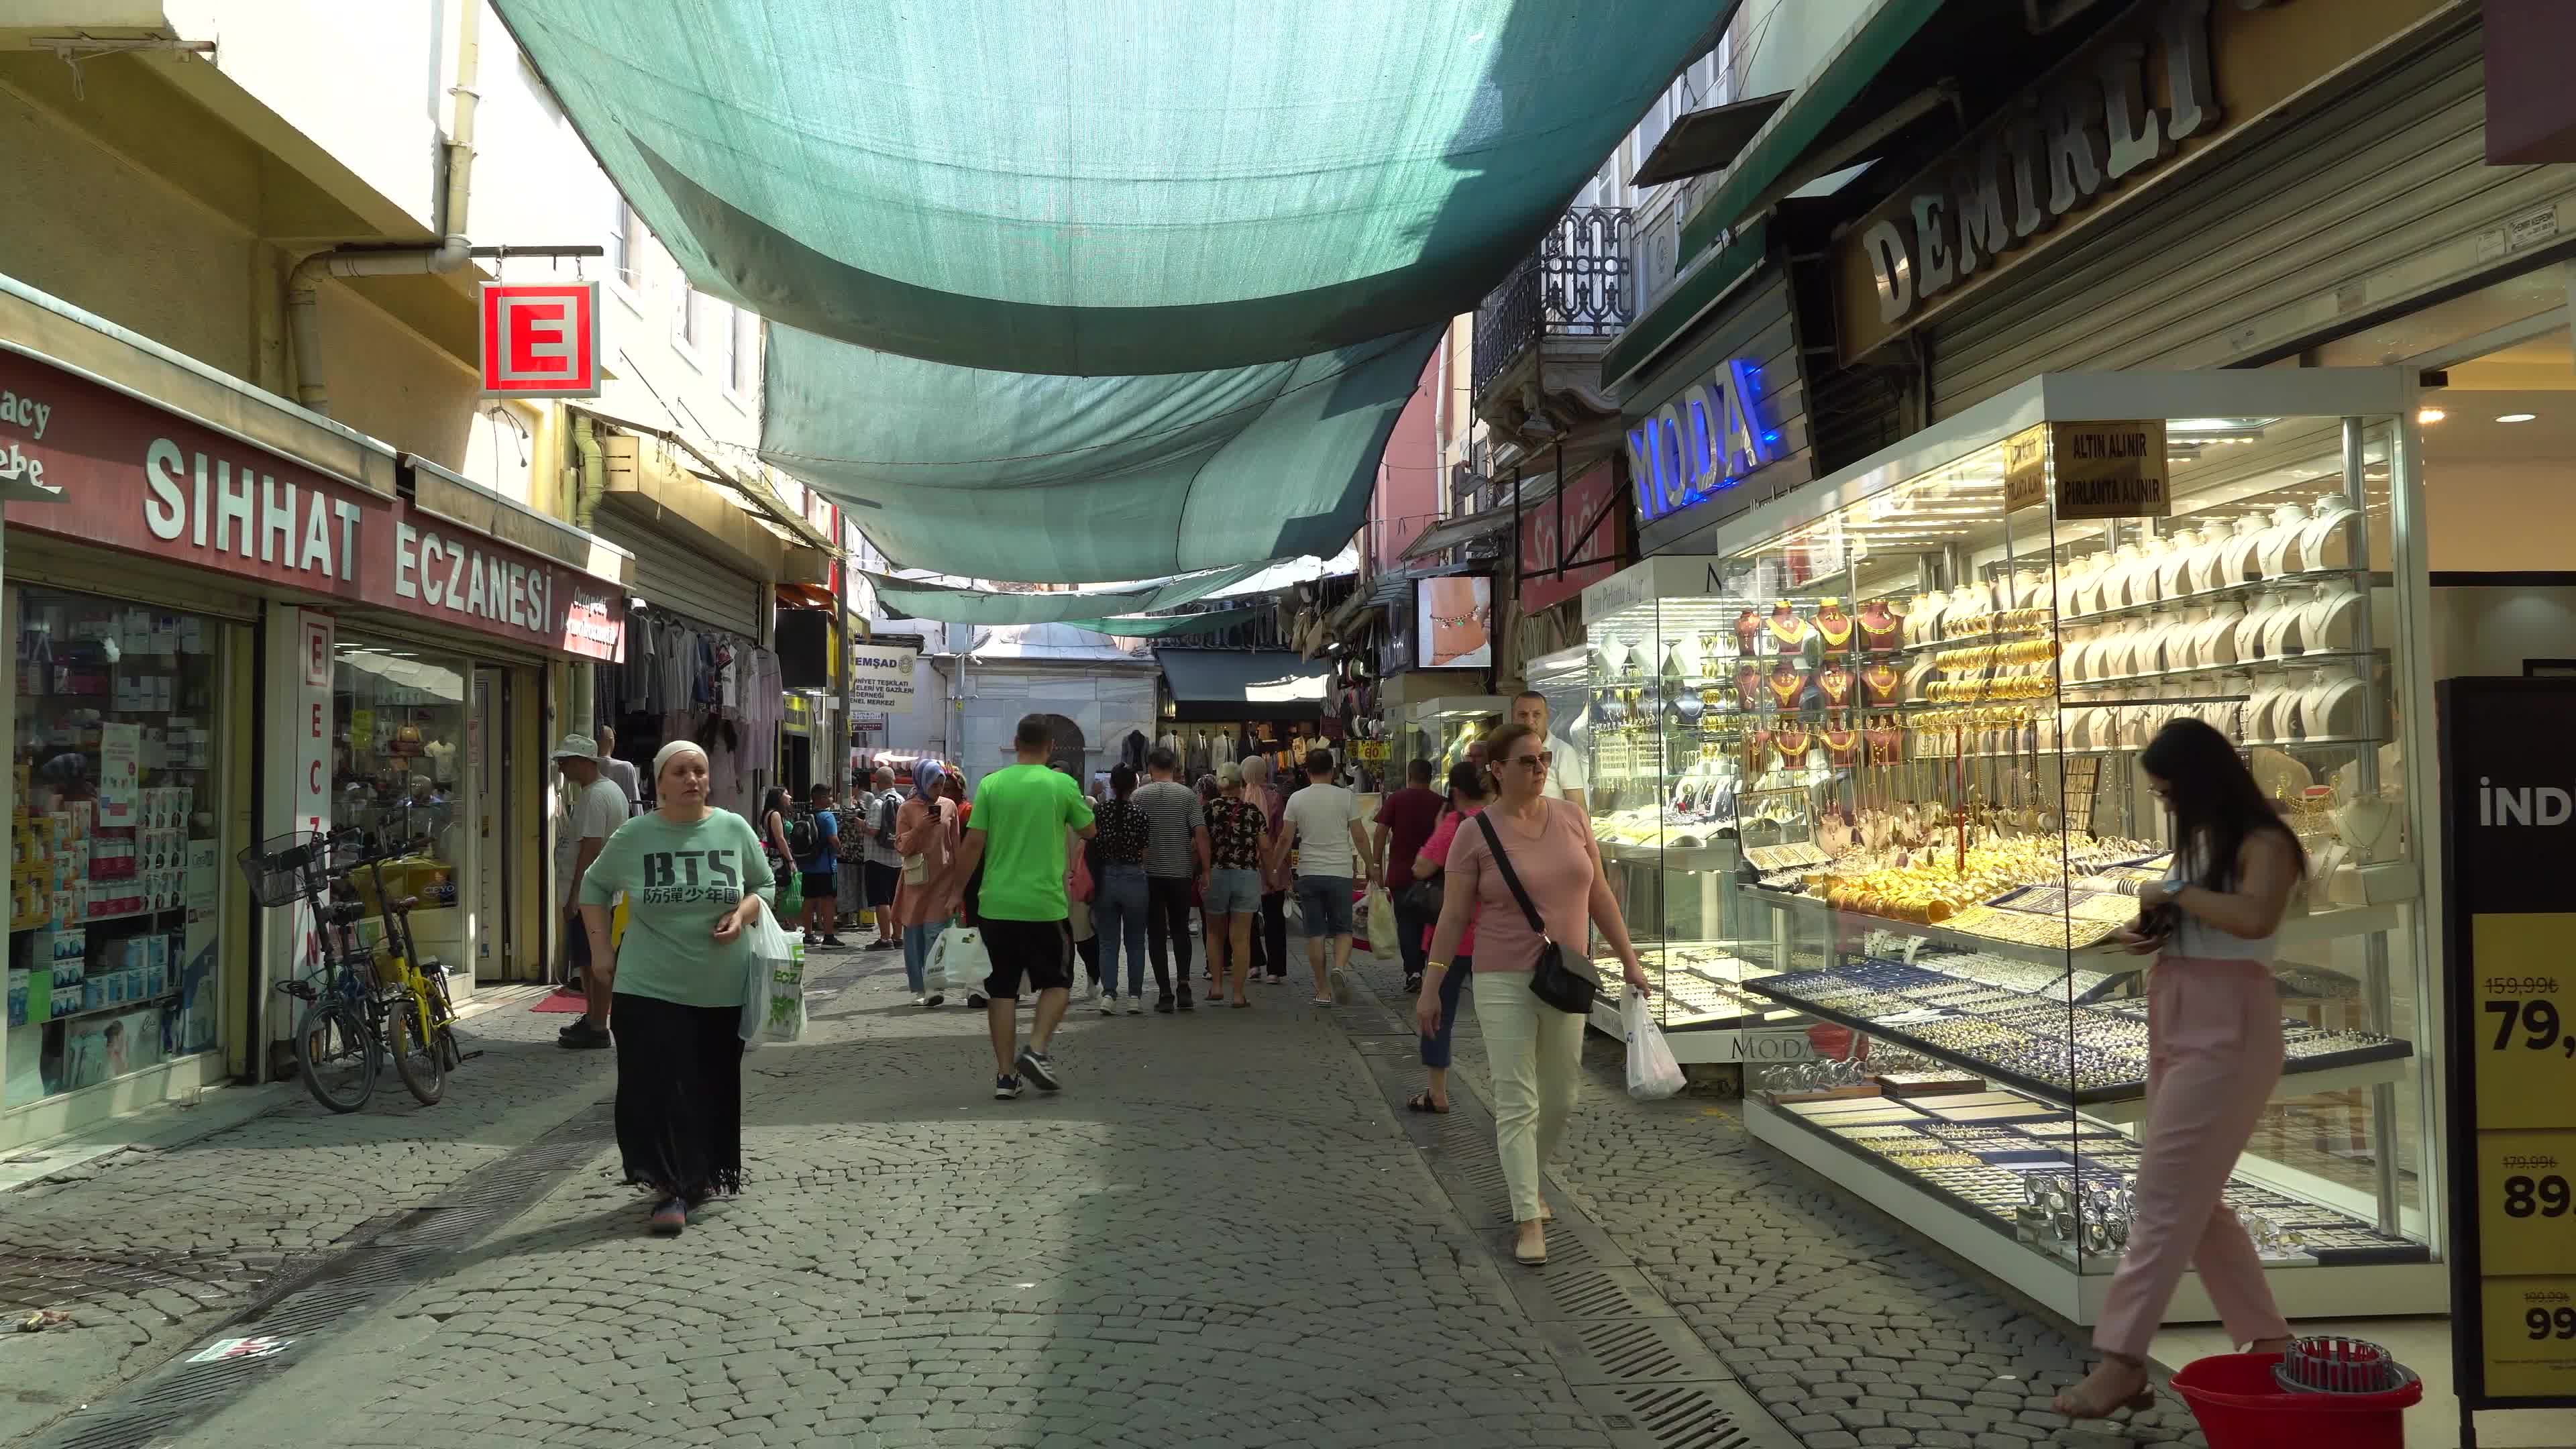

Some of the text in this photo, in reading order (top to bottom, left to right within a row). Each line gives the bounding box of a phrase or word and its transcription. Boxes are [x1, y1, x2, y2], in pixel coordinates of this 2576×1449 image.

[510, 304, 568, 372] E
[1627, 360, 1763, 522] MODA
[2074, 433, 2147, 459] ALTIN ALINIR
[144, 437, 360, 581] SIHHAT
[2065, 478, 2161, 504] PIRLANTA ALINIR
[396, 521, 552, 633] ECZANESİ
[311, 635, 323, 674] E
[855, 657, 897, 669] EMŞAD
[877, 679, 908, 687] TEŞKİLATI
[885, 685, 914, 694] GAZİLERİ
[1364, 747, 1380, 757] 60
[2479, 775, 2576, 826] İND
[643, 850, 738, 887] BTS
